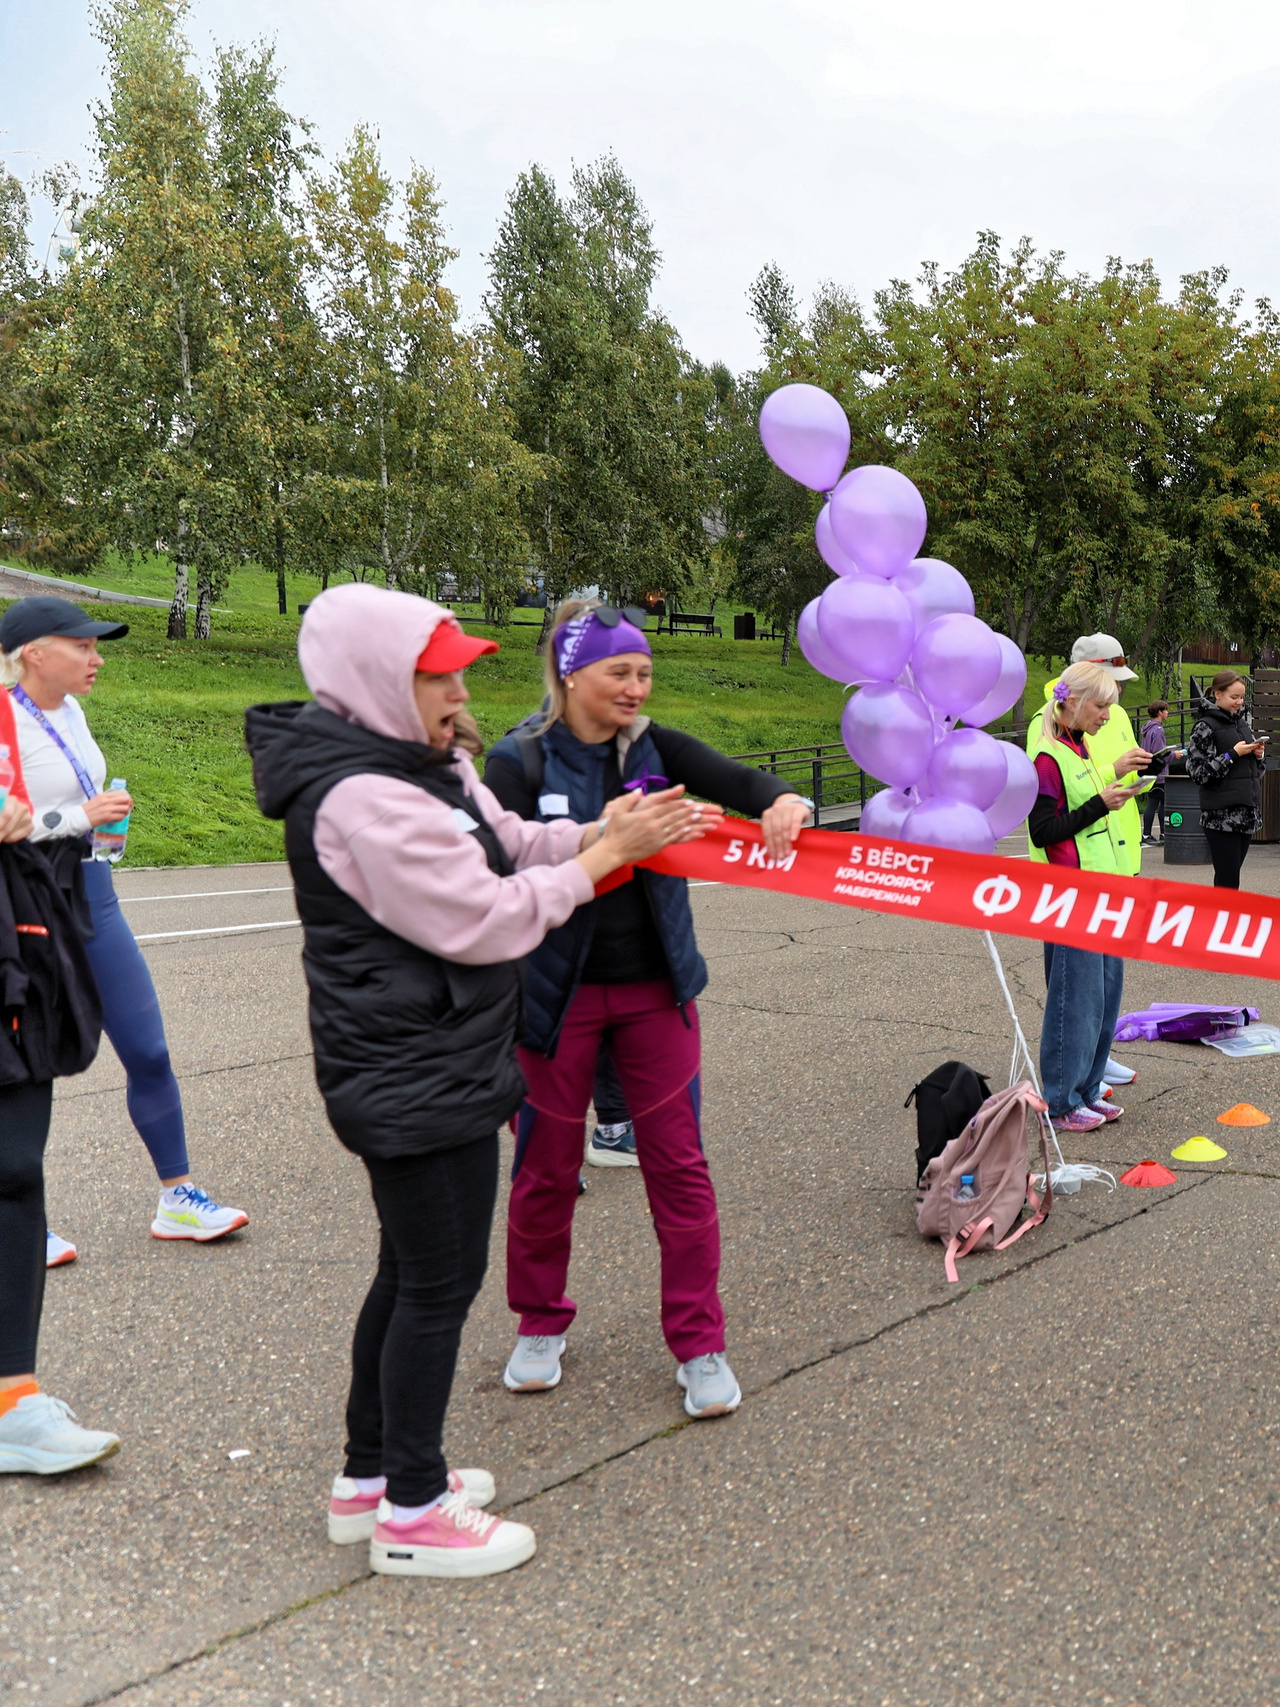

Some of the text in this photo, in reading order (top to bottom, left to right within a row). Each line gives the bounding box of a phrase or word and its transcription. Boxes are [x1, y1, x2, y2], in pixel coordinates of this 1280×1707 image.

[723, 840, 744, 863] 5
[849, 846, 934, 875] 5 ВЁРСТ
[835, 867, 935, 893] КРАСНОЯРСК
[834, 883, 922, 907] НАБЕРЕЖНАЯ
